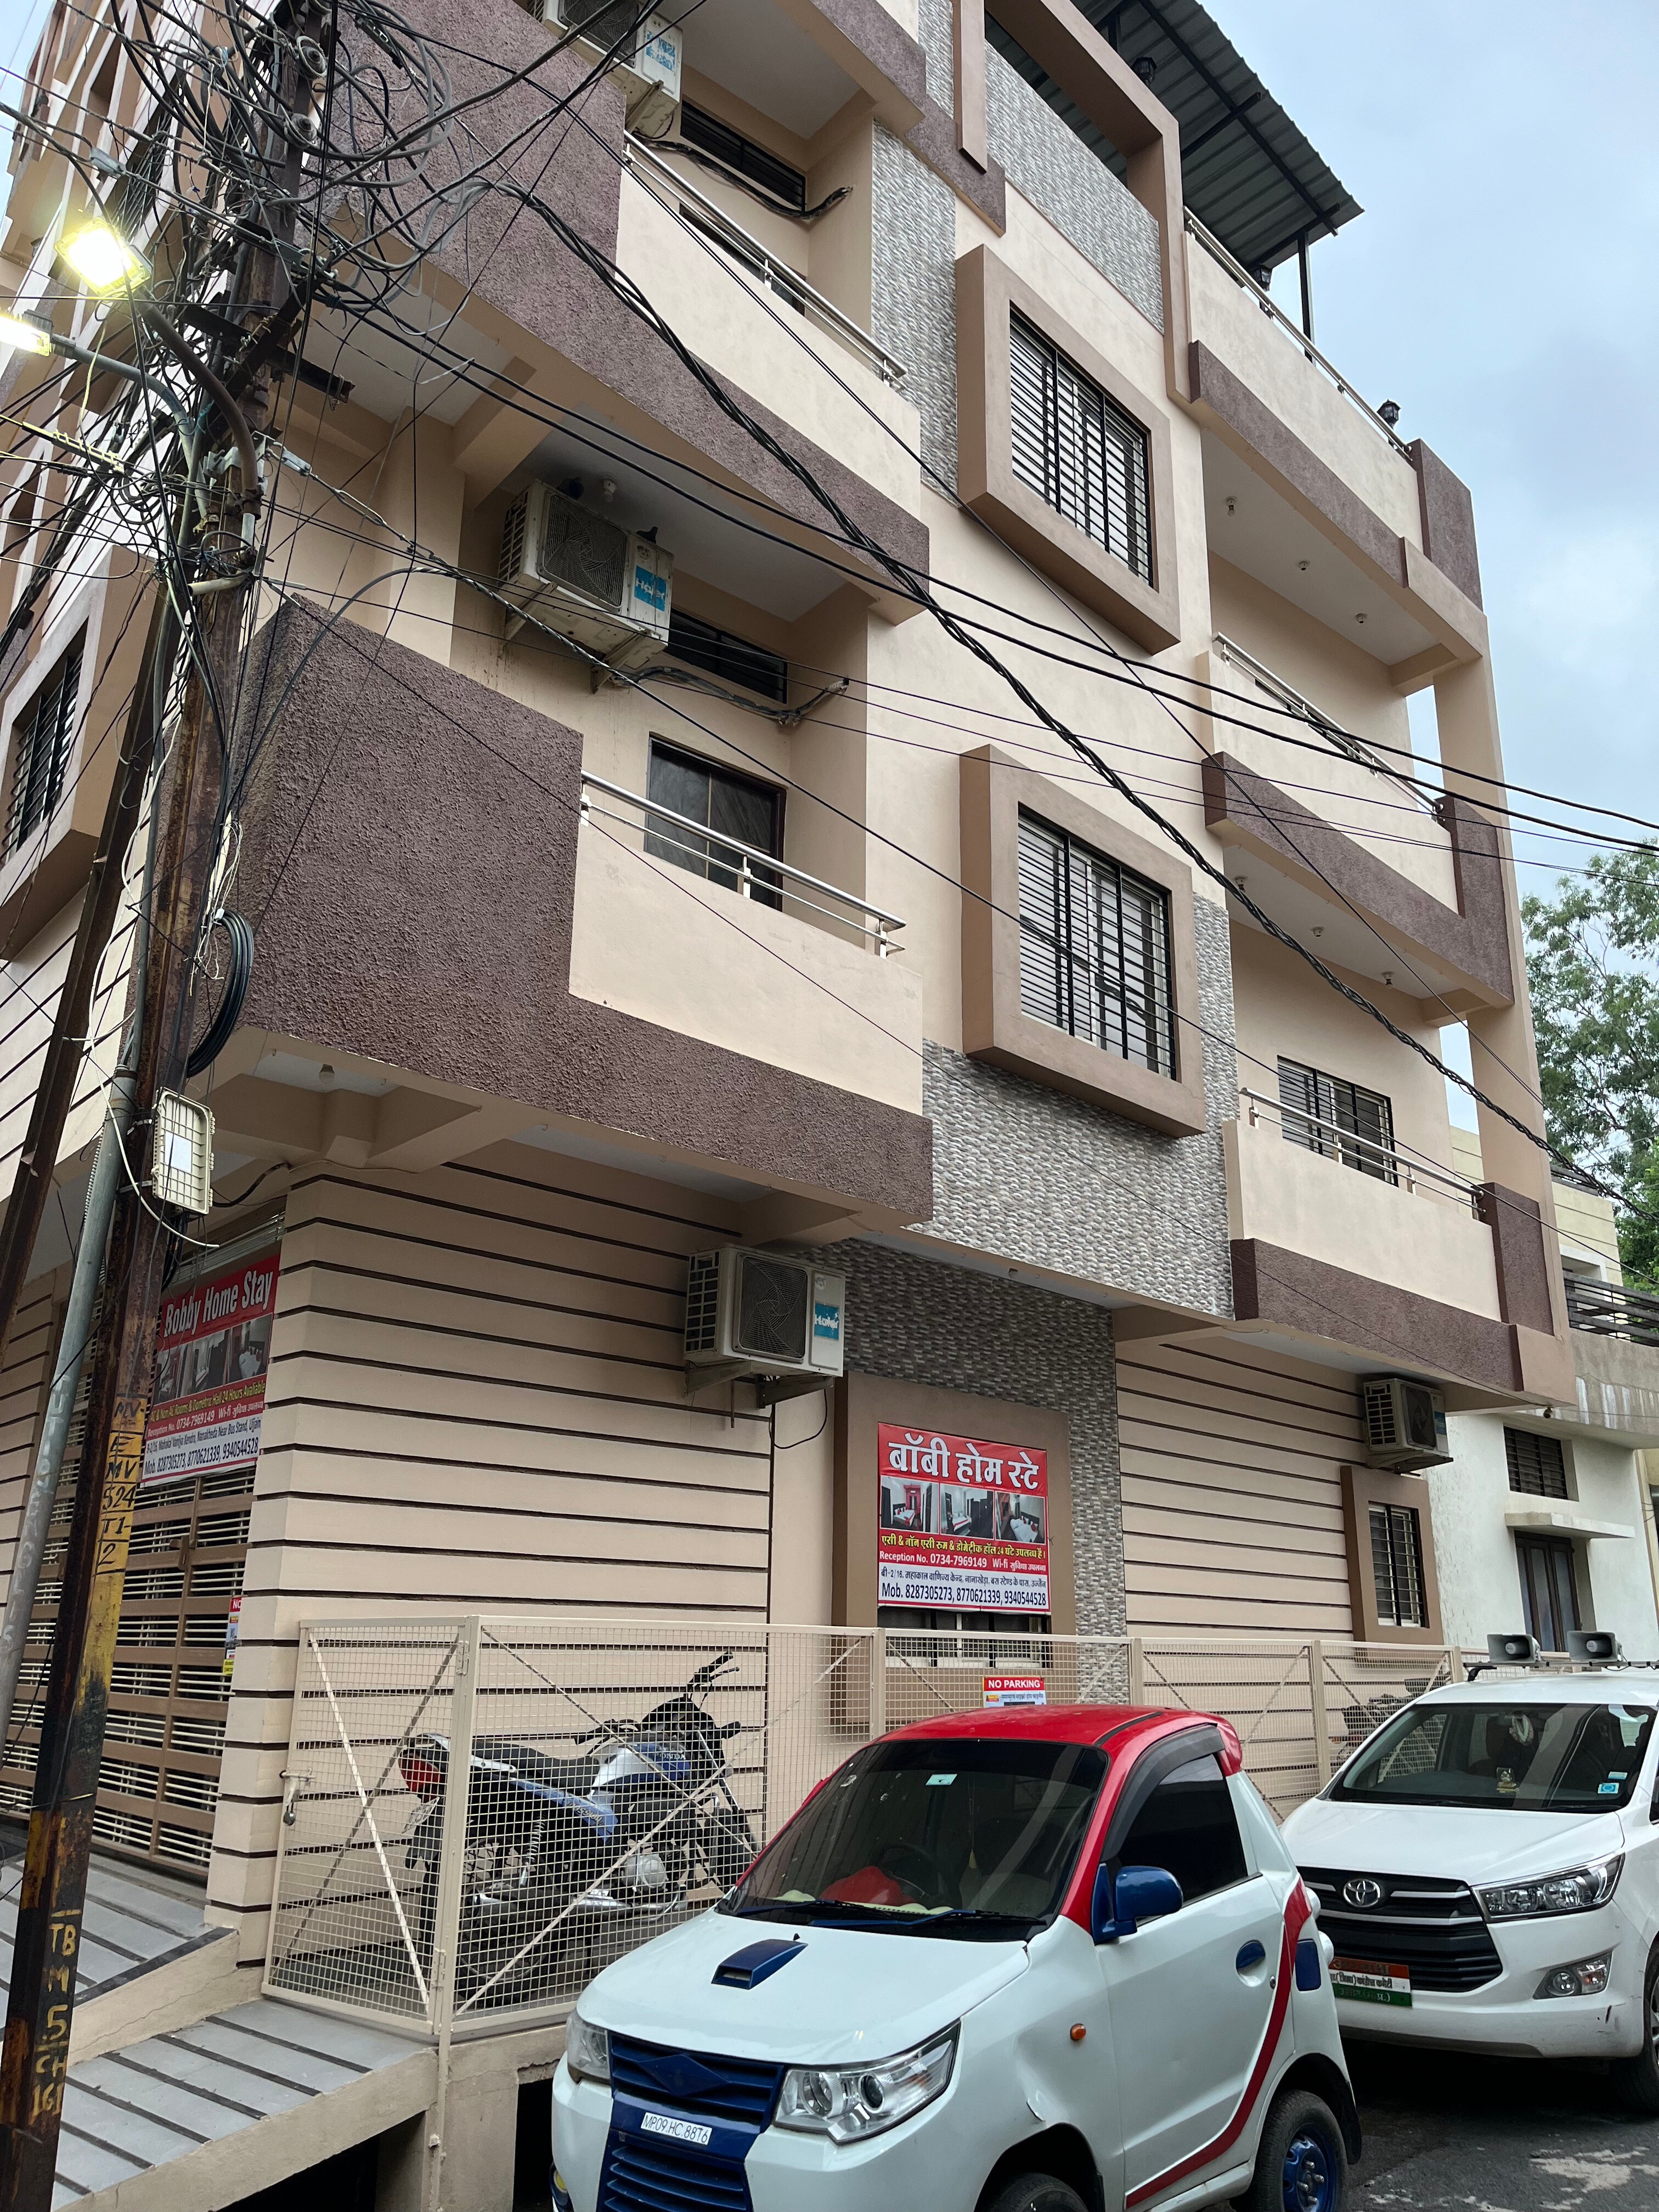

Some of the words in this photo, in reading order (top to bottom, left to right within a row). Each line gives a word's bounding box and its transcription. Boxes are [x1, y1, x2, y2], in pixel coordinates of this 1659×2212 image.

[164, 1295, 201, 1338] Bobby
[202, 1284, 238, 1323] Home
[242, 1271, 273, 1311] Stay
[229, 1387, 243, 1402] Hours
[218, 1404, 232, 1419] Wi-fi
[222, 1437, 259, 1460] 9340544528
[888, 1432, 950, 1477] बॉबी
[955, 1442, 1003, 1485] होम
[1008, 1452, 1039, 1489] स्टे
[881, 1533, 896, 1546] एसी
[898, 1535, 904, 1546] &
[905, 1535, 919, 1548] नॉन
[921, 1537, 935, 1549] एसी
[949, 1540, 955, 1551] &
[983, 1542, 996, 1555] हॉल
[997, 1546, 1004, 1555] 24
[1015, 1548, 1037, 1558] उपलब्ध
[879, 1550, 915, 1562] Reception
[916, 1554, 928, 1563] No.
[930, 1553, 987, 1568] 0734-7969149
[992, 1558, 1008, 1568] Wi-fi
[1009, 1560, 1027, 1571] सुविधा
[1028, 1564, 1046, 1572] उपलब्ध
[905, 1571, 928, 1581] महाकाल
[929, 1570, 949, 1582] वाणिज्य
[1013, 1576, 1019, 1586] के
[1031, 1578, 1046, 1588] उज्जैन
[882, 1582, 903, 1599] Mob.
[905, 1584, 955, 1604] 8287305273,
[956, 1587, 1002, 1606] 8770621339,
[1005, 1590, 1046, 1606] 9340544528
[988, 1679, 1002, 1688] NO
[1004, 1679, 1040, 1688] PARKING
[49, 1923, 76, 1957] TB
